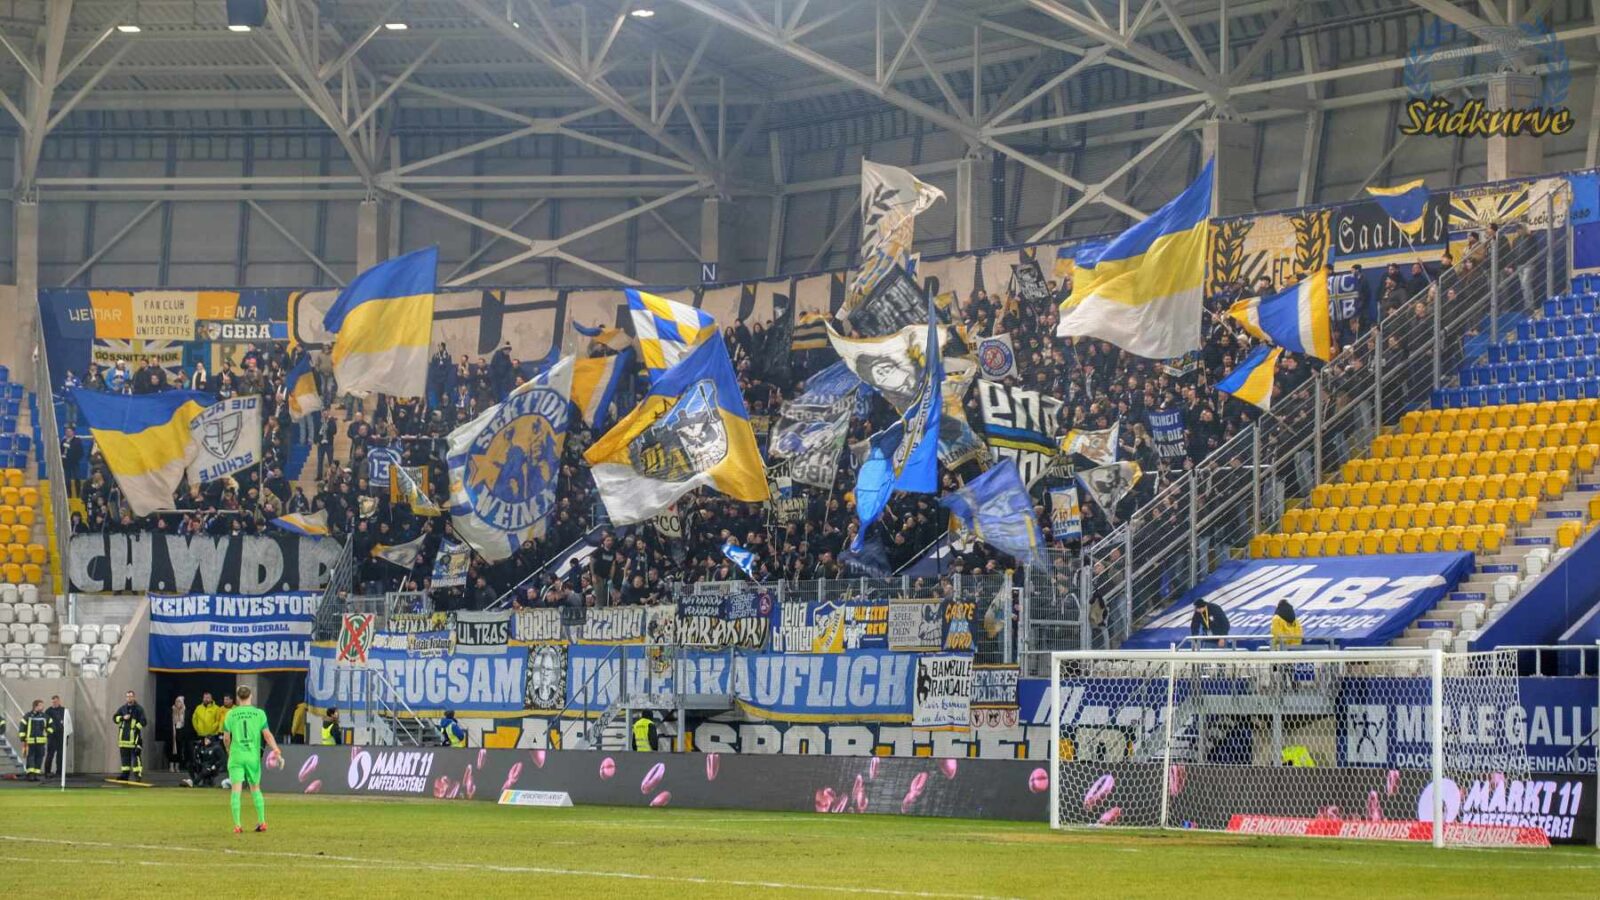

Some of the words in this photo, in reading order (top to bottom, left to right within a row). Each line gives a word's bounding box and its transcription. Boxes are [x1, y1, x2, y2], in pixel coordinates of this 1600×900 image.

[702, 263, 716, 281] N
[222, 323, 271, 339] GERA
[476, 389, 569, 449] SEKTION
[373, 458, 391, 479] 13
[1241, 574, 1447, 611] ABZ
[151, 594, 210, 617] KEINE
[209, 623, 230, 633] HIER
[232, 624, 250, 633] UND
[251, 622, 290, 634] ÜBERALL
[457, 622, 508, 645] ULTRAS
[676, 615, 769, 649] HARAKIRI
[182, 641, 207, 662] IM
[931, 659, 972, 678] BAMBULE
[931, 678, 970, 697] RANDALE
[371, 751, 421, 776] MARKT
[420, 752, 434, 777] 11
[368, 775, 427, 793] KAFFEERÖSTEREI
[1463, 780, 1556, 815] MARKT
[1558, 781, 1583, 816] 11
[1238, 818, 1310, 834] REMONDIS
[1339, 821, 1412, 838] REMONDIS
[1443, 826, 1520, 844] REMONDIS
